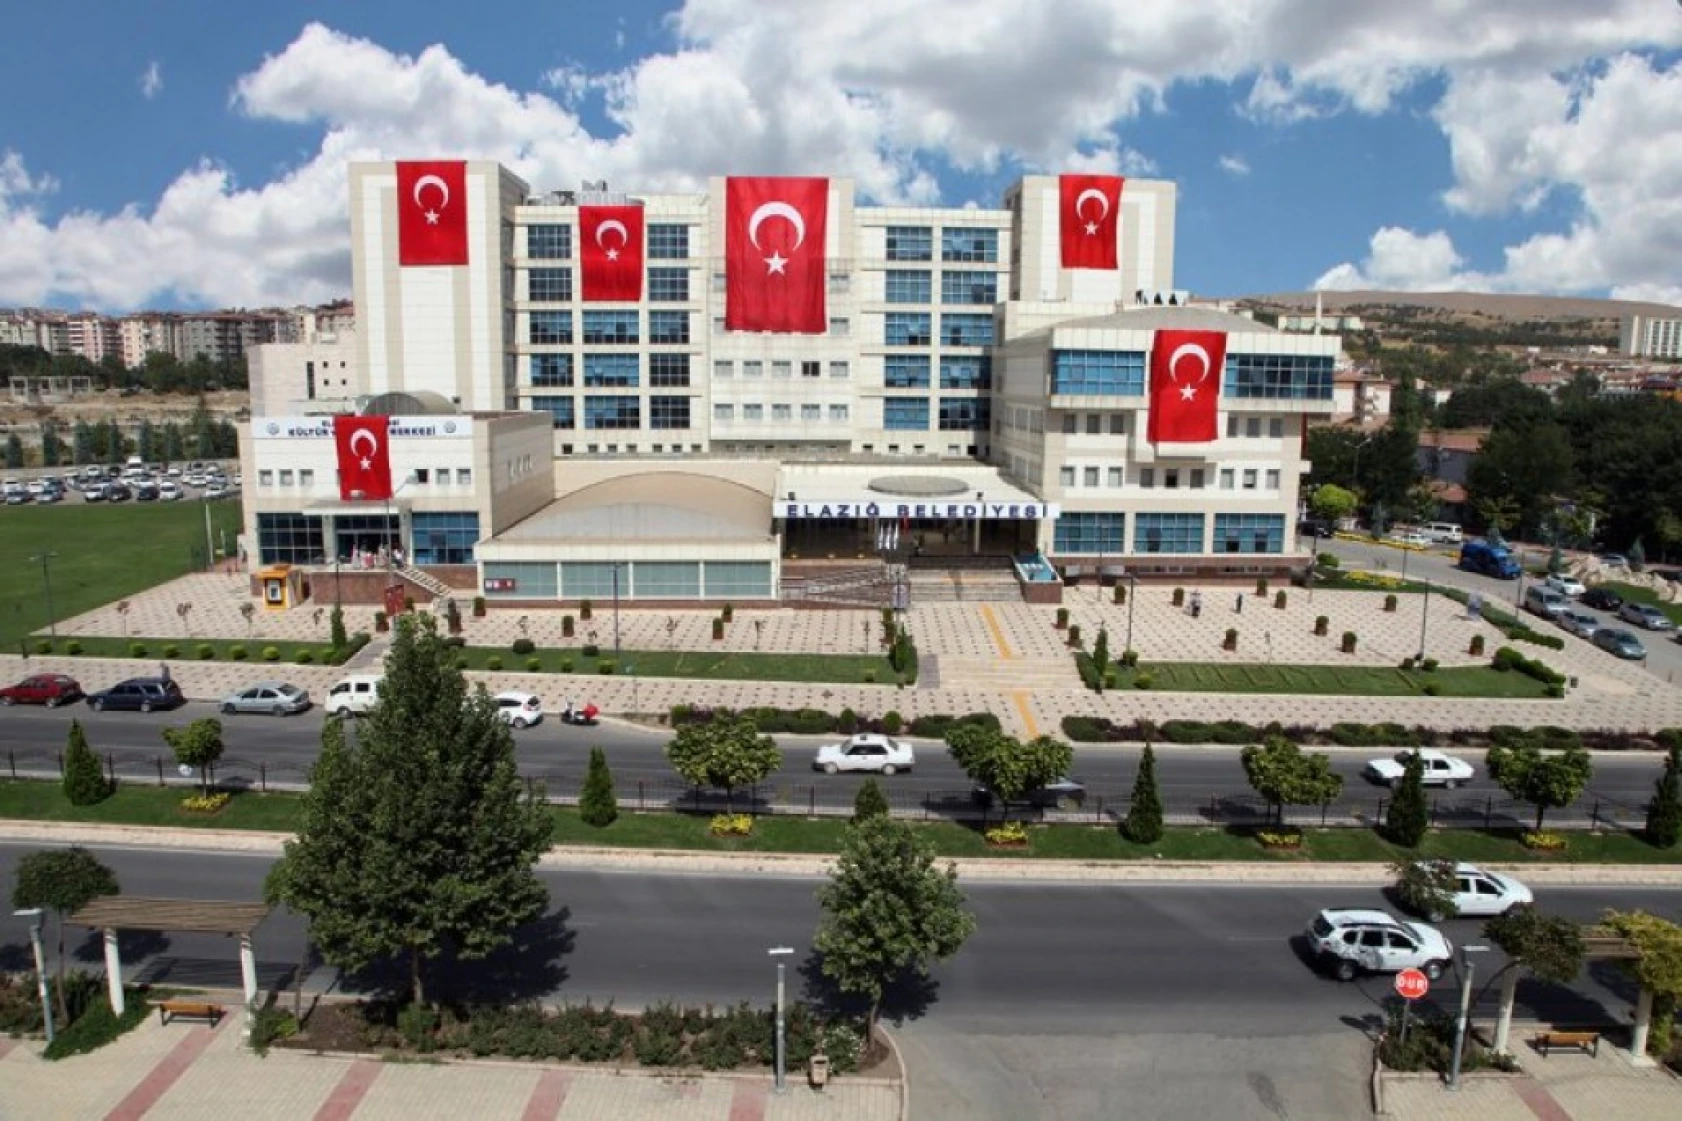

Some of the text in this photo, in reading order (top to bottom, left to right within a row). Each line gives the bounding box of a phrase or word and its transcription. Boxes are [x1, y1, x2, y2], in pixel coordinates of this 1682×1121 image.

[786, 502, 1047, 518] ELAZIĞ BELEDİYESİ
[1397, 975, 1425, 990] DUR
